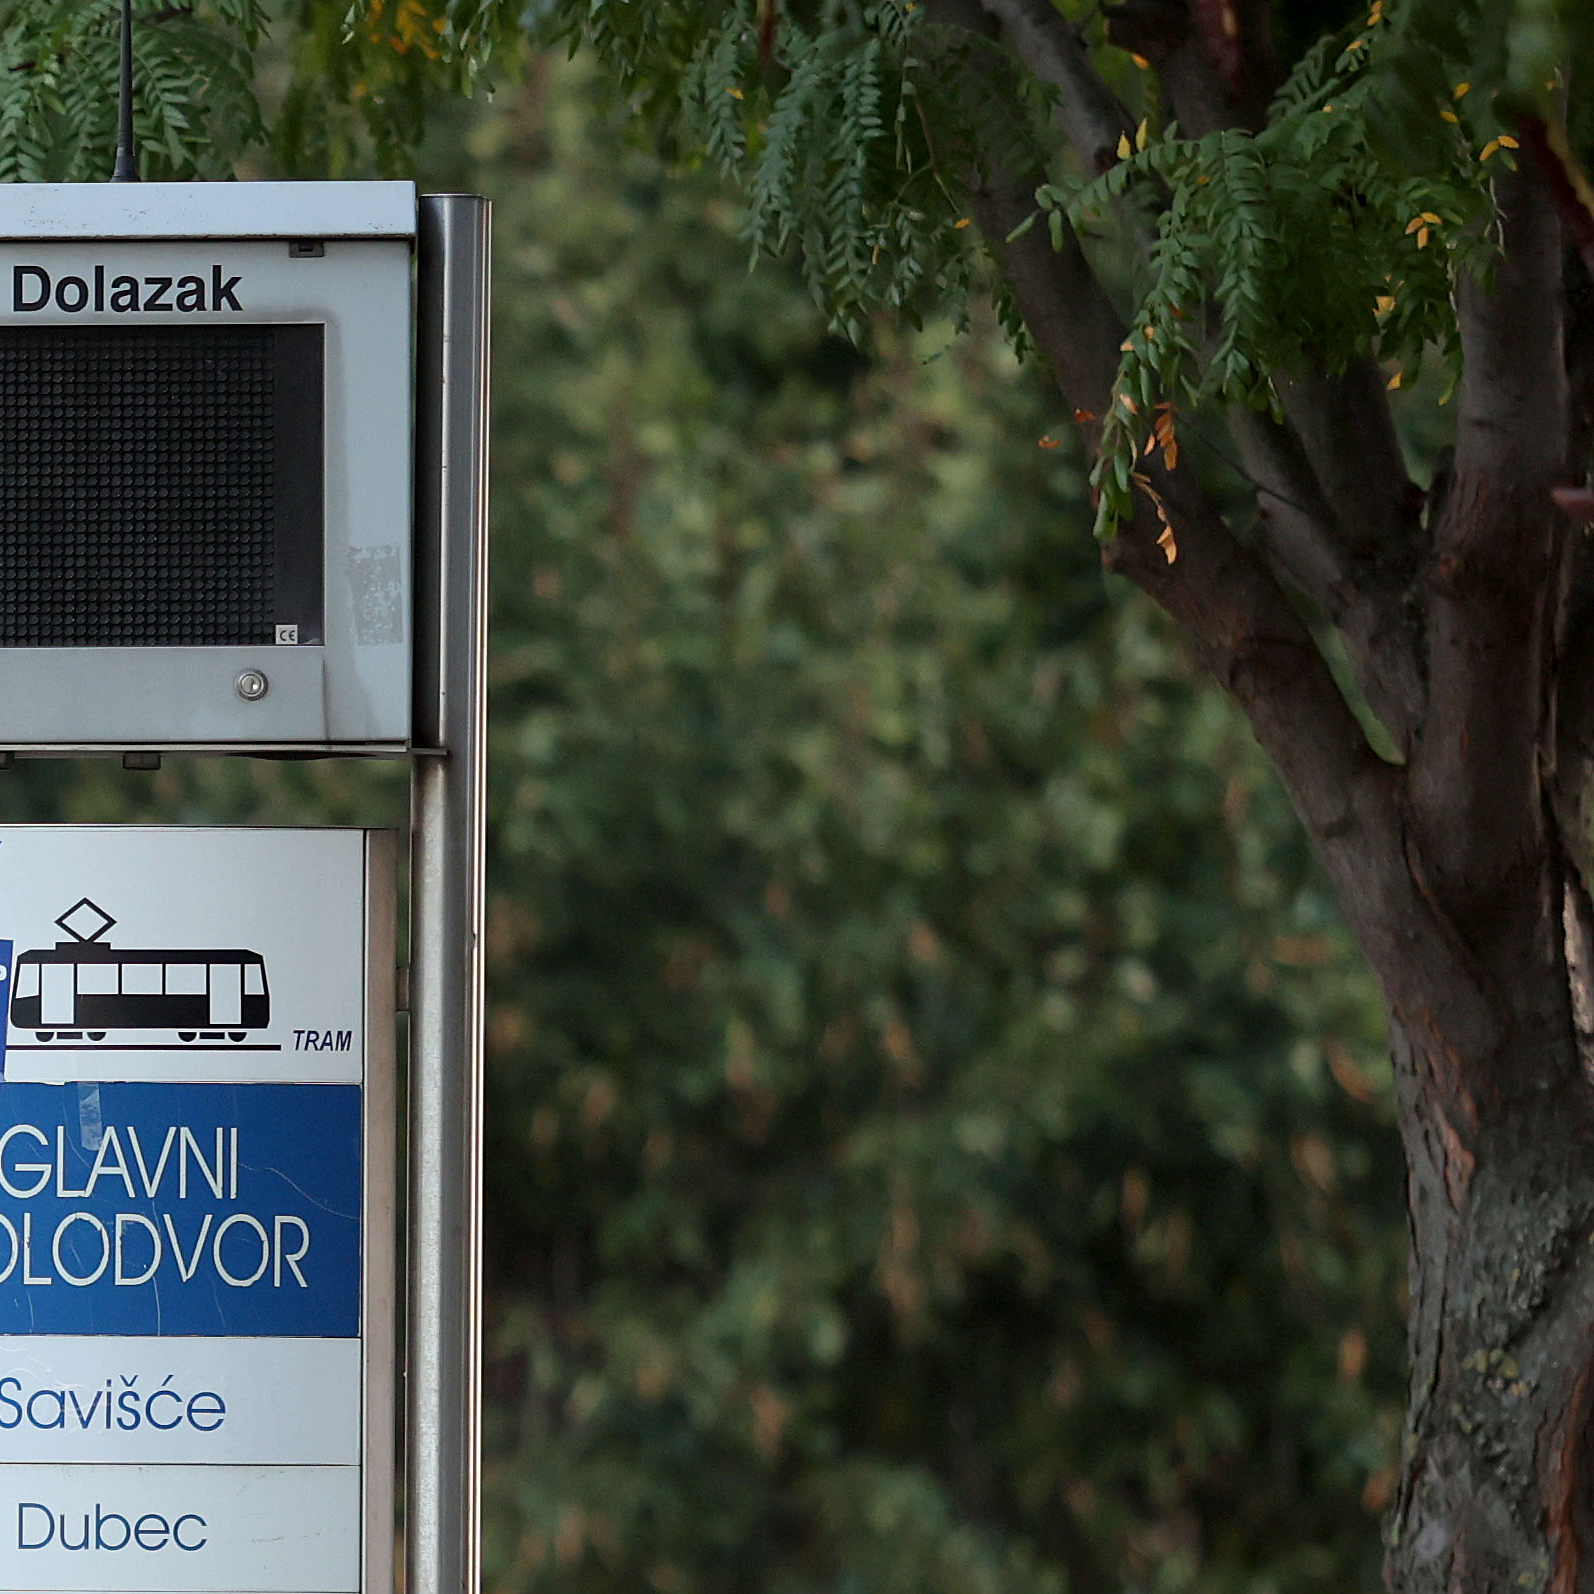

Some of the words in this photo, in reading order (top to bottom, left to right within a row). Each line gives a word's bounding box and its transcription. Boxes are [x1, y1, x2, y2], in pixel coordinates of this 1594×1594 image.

[14, 265, 243, 312] Dolazak
[293, 1030, 352, 1052] TRAM
[18, 1503, 208, 1551] Dubec
